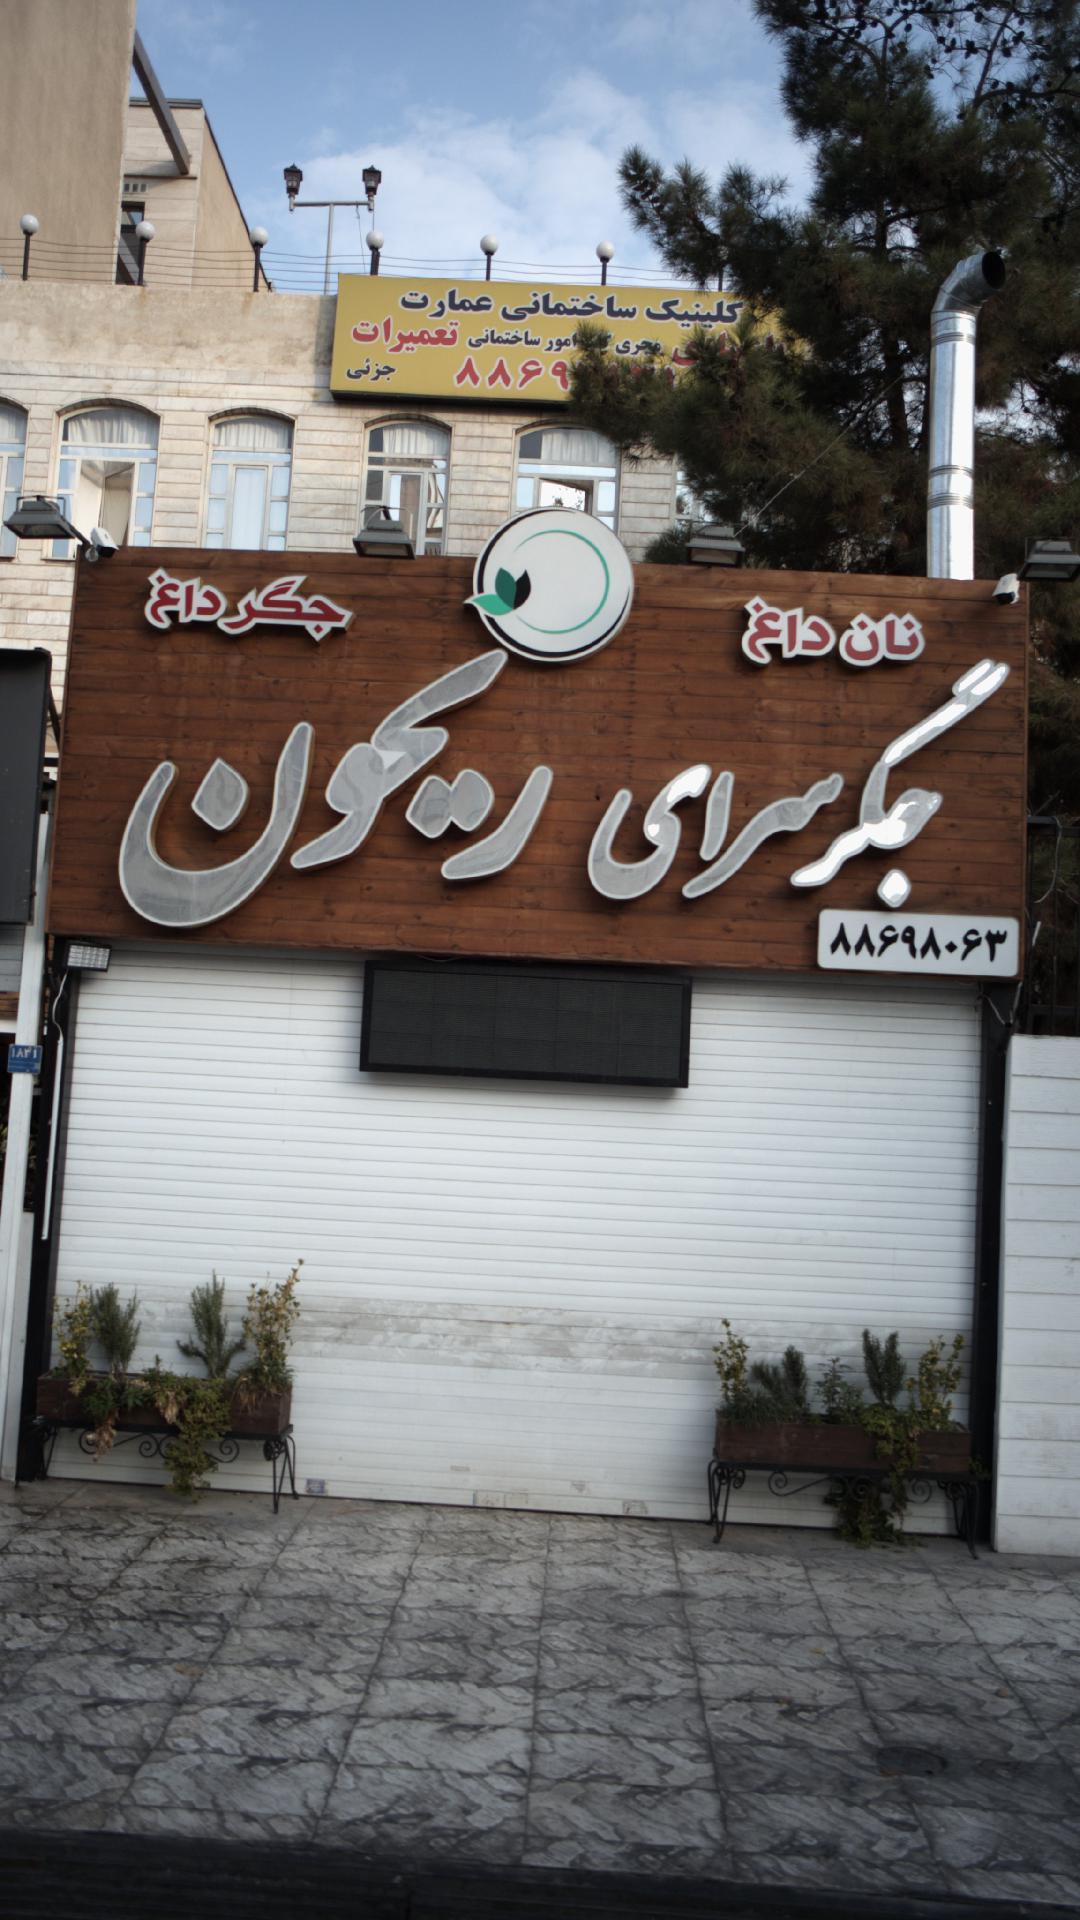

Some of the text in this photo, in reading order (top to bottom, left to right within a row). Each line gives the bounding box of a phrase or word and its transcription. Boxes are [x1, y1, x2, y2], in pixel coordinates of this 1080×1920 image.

[400, 288, 742, 329] کلینیک ساختمانی عمارت
[351, 317, 459, 353] تعمیرات
[467, 328, 541, 348] ساختمانی
[346, 356, 396, 382] جزئی
[145, 567, 354, 642] جگر داغ
[741, 595, 926, 667] نان داغ
[830, 922, 1008, 962] ۸۸۶۹۸۰۶۳
